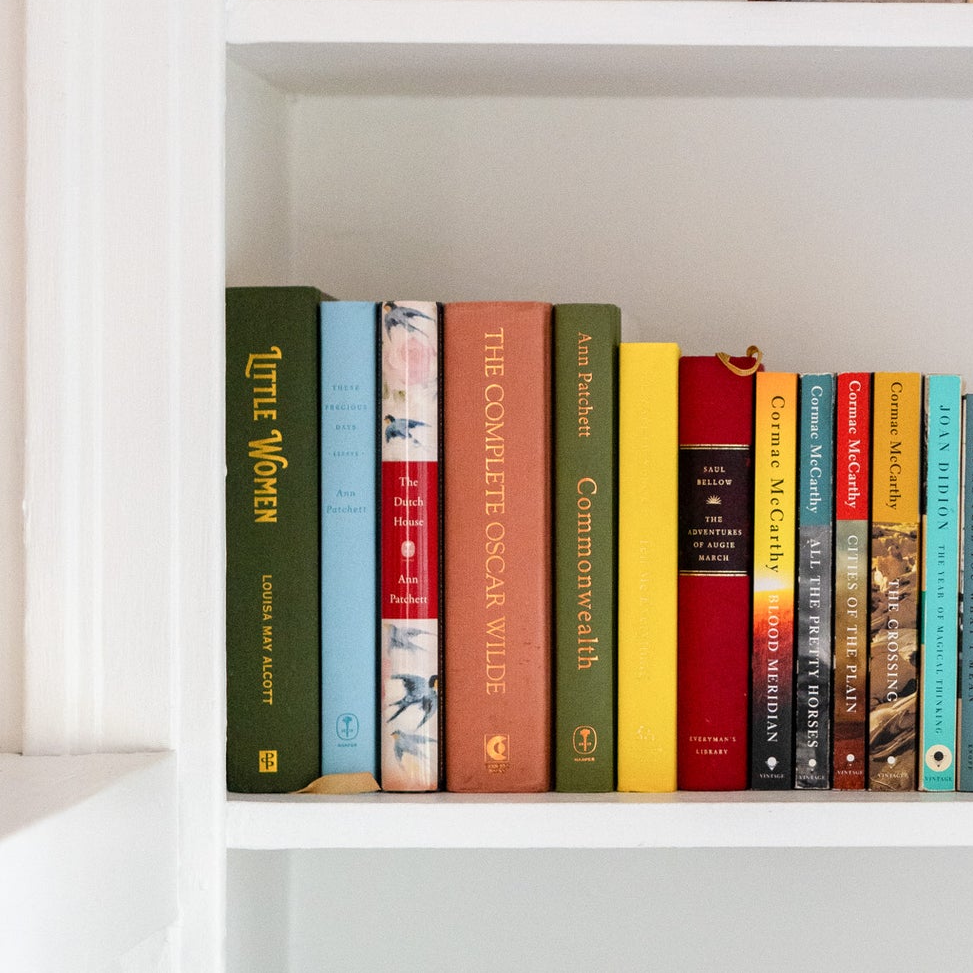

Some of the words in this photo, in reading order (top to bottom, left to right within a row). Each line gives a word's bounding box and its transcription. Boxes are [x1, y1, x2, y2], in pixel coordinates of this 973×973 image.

[484, 327, 504, 378] THE
[577, 331, 592, 367] Ann
[245, 345, 283, 421] LITTLE
[577, 372, 593, 438] Patchett
[847, 379, 862, 435] Cormac
[889, 381, 904, 436] Cormac
[770, 395, 787, 469] Cormac
[809, 385, 824, 440] Cormac
[938, 405, 951, 452] JOAN
[484, 383, 505, 516] COMPLETE
[844, 438, 862, 509] McCarthy
[247, 429, 289, 524] WOMEN
[335, 489, 356, 498] Ann
[398, 476, 418, 487] The
[696, 478, 733, 486] BELLOW
[806, 444, 823, 514] McCarthy
[885, 440, 903, 511] McCarthy
[937, 461, 951, 531] DIDION
[326, 504, 367, 515] Patchett
[393, 496, 424, 507] Dutch
[393, 516, 424, 527] House
[766, 478, 785, 574] McCarthy
[687, 528, 743, 536] ADVENTURES
[808, 539, 821, 569] ALL
[937, 544, 946, 567] THE
[397, 574, 419, 585] Ann
[485, 522, 506, 609] OSCAR
[576, 476, 599, 671] Commonwealth
[698, 554, 729, 562] MARCH
[846, 534, 859, 591] CITIES
[262, 574, 273, 621] LOUISA
[389, 593, 428, 605] Patchett
[808, 575, 821, 609] THE
[846, 597, 859, 619] OF
[888, 578, 901, 612] THE
[937, 571, 946, 599] YEAR
[262, 625, 273, 652] MAY
[766, 594, 779, 653] BLOOD
[936, 606, 945, 622] OF
[486, 616, 507, 696] WILDE
[807, 615, 821, 679] PRETTY
[846, 624, 858, 658] THE
[886, 618, 900, 703] CROSSING
[935, 625, 945, 676] MAGICAL
[262, 656, 273, 706] ALCOTT
[766, 658, 779, 743] MERIDIAN
[845, 664, 858, 714] PLAIN
[934, 678, 945, 735] THINKING
[806, 684, 820, 749] HORSES
